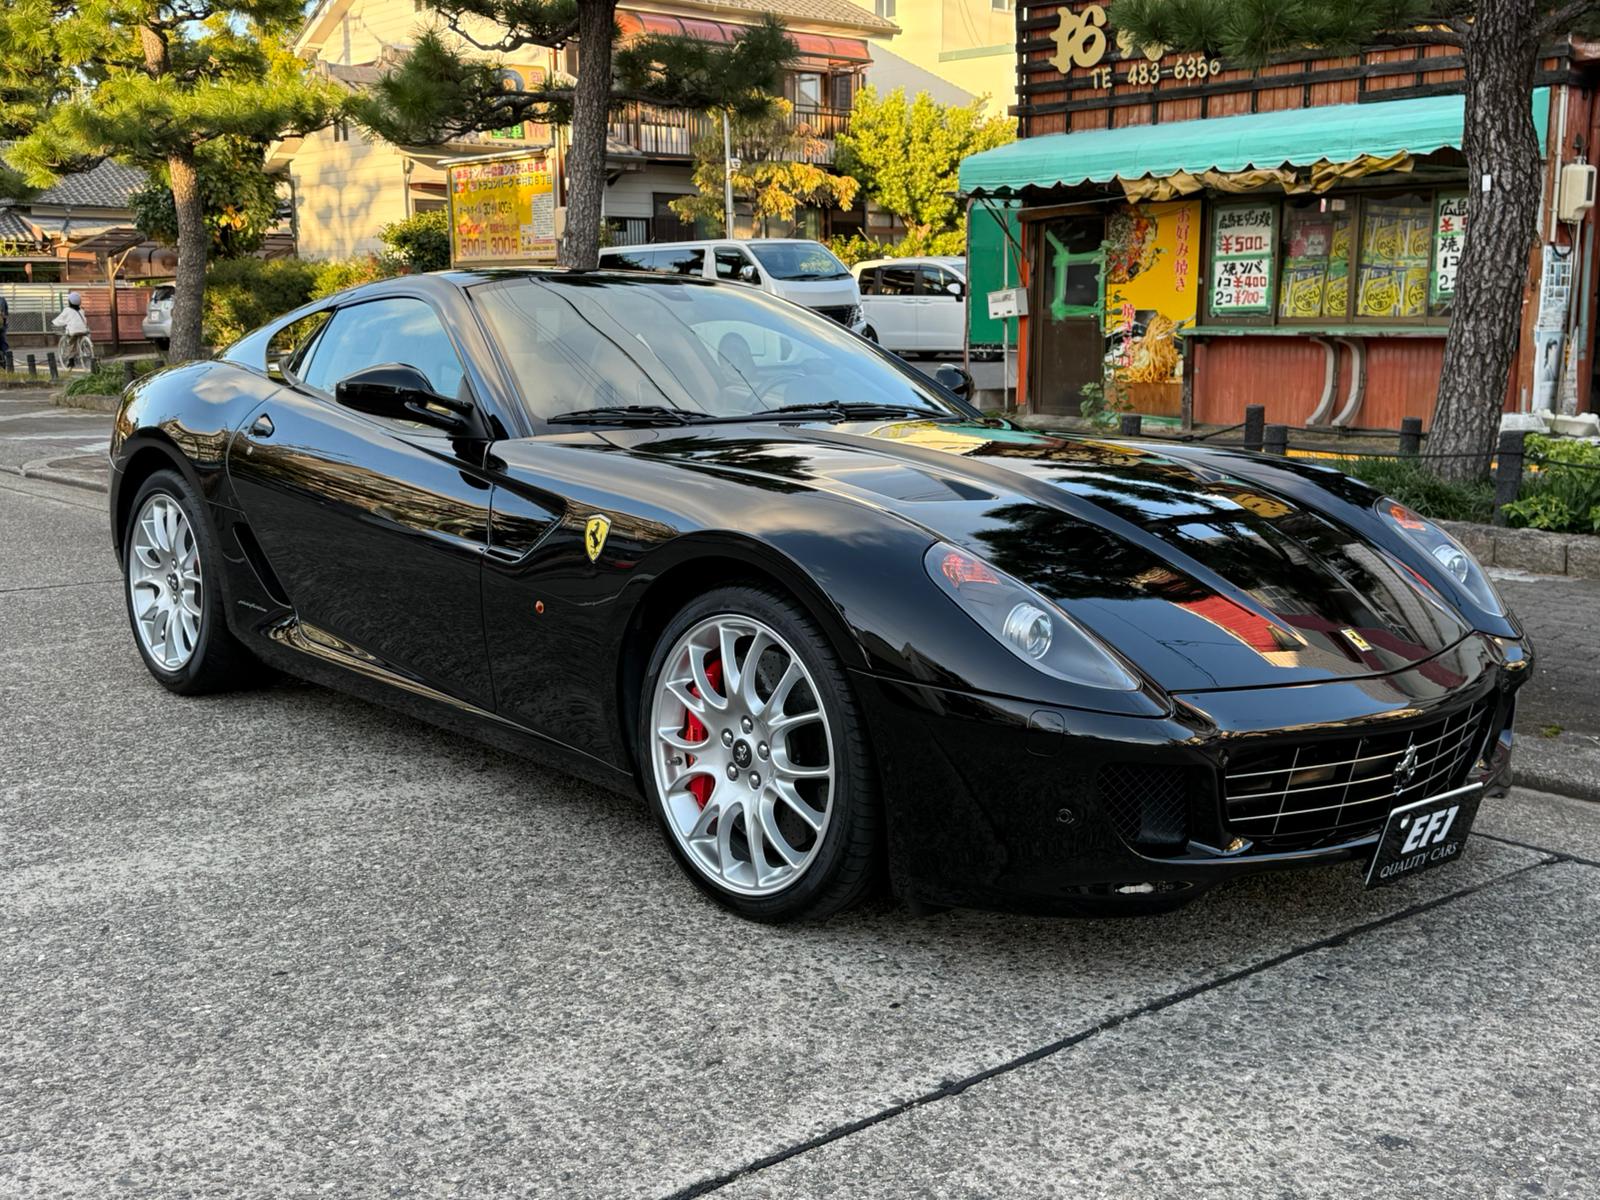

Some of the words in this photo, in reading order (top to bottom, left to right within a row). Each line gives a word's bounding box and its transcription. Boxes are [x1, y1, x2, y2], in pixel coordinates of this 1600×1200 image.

[1127, 57, 1221, 87] 483-6356
[461, 237, 487, 257] 500円
[491, 236, 518, 255] 300円
[1174, 207, 1190, 293] お好み焼き
[1401, 806, 1459, 854] EFJ
[1381, 851, 1430, 878] QUALITY
[1431, 842, 1459, 861] CARS
